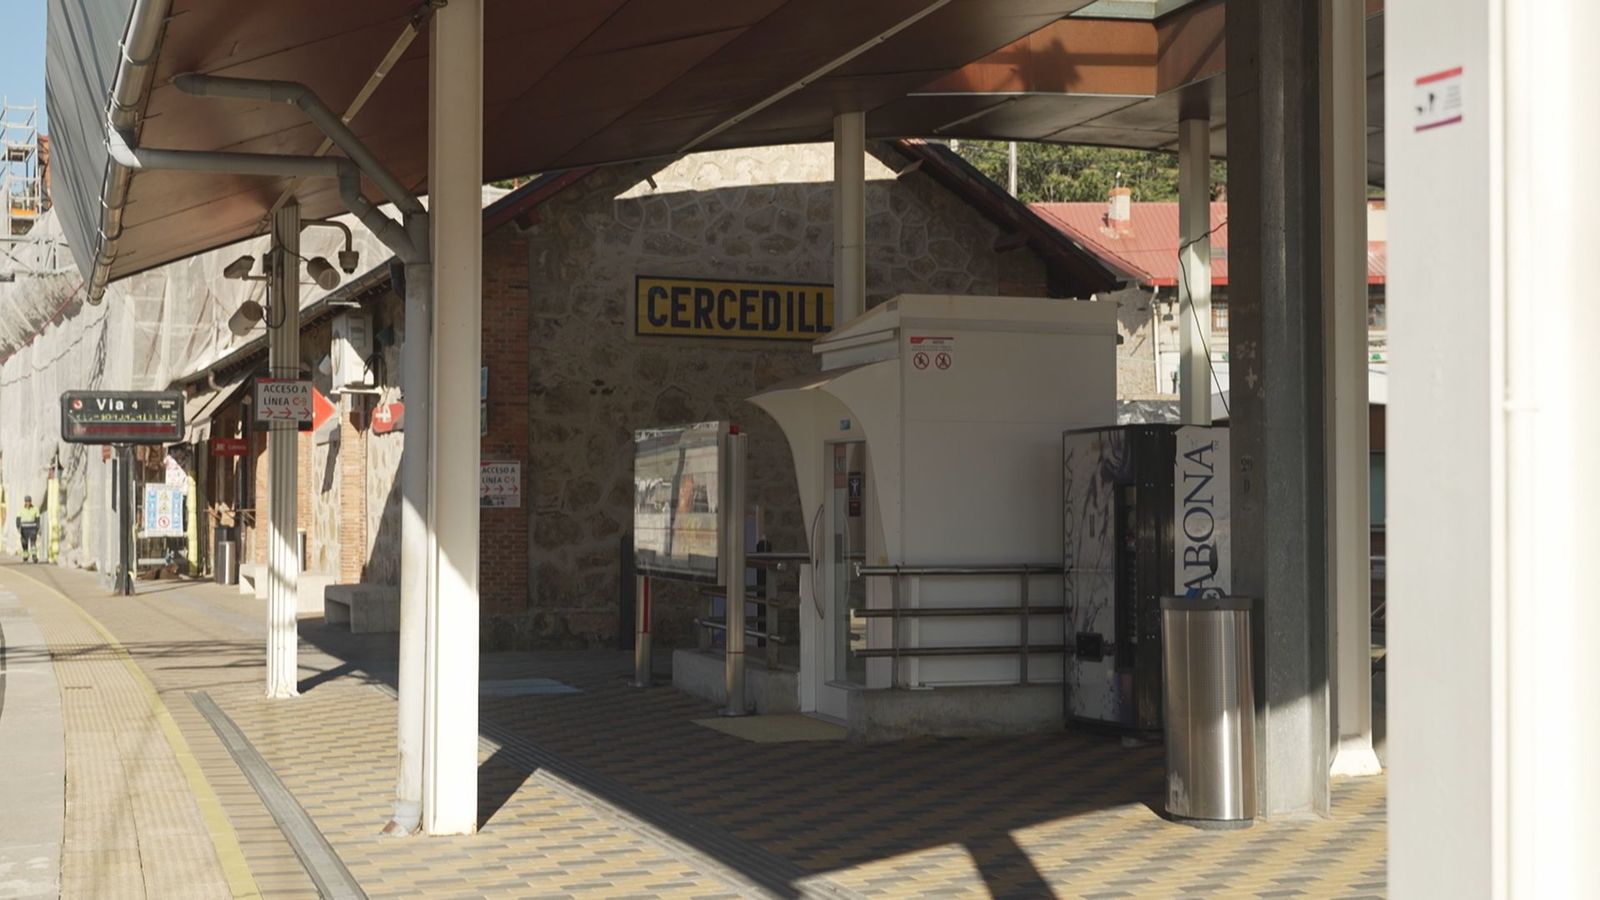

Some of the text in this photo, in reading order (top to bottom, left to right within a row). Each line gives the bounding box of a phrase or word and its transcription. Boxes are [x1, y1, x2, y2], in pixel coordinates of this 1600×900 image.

[647, 285, 832, 333] CERCEDILL
[263, 384, 307, 394] ACCESO A
[131, 400, 138, 410] 4
[263, 395, 290, 406] LÍNEA
